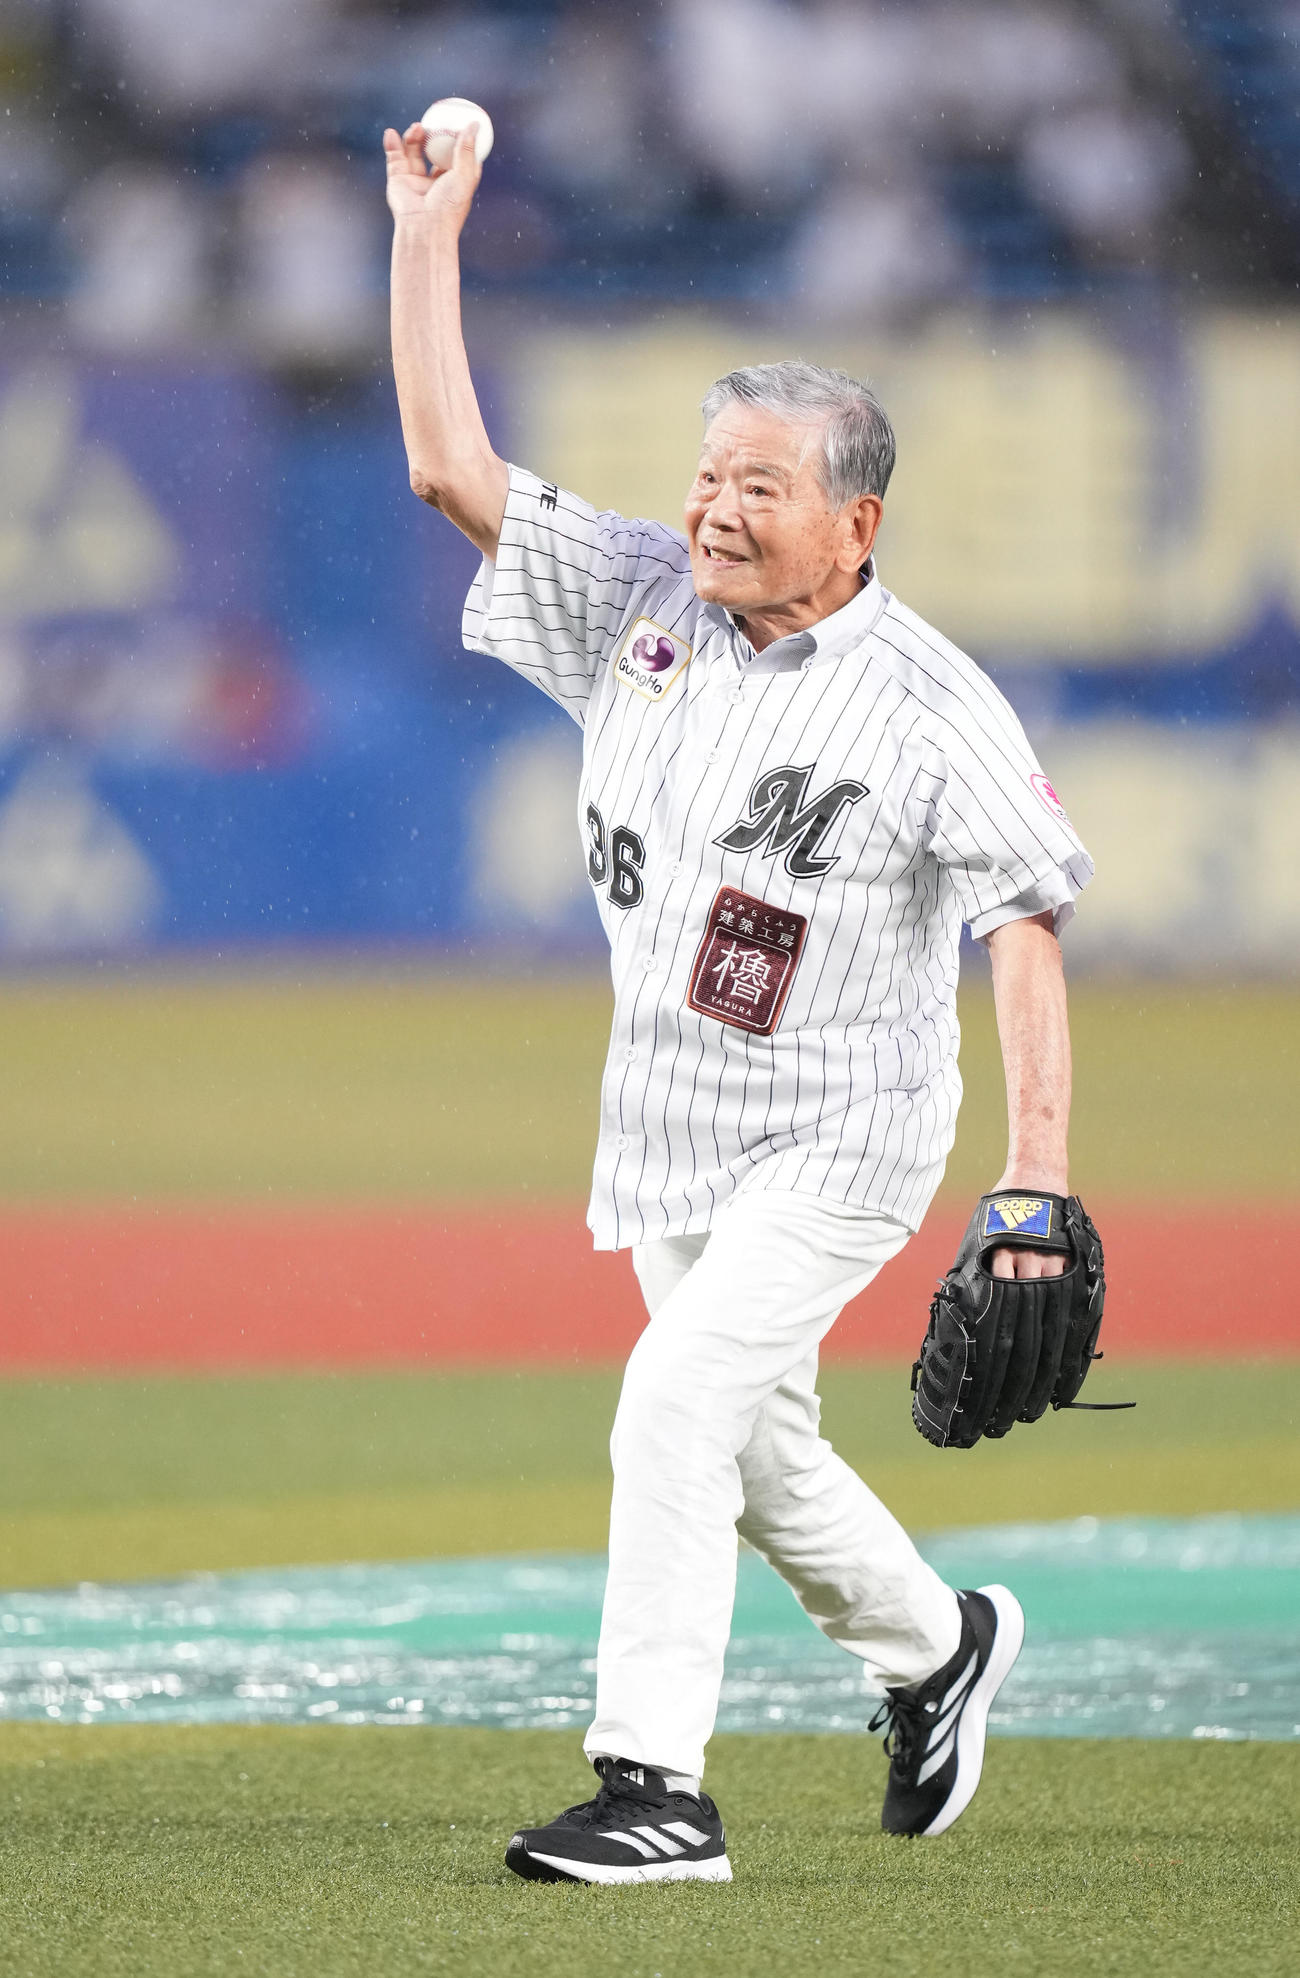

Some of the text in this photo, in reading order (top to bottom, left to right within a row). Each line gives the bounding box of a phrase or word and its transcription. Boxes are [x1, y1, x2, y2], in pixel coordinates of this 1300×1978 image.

[540, 483, 558, 512] TE
[618, 656, 663, 694] GungHo
[711, 762, 871, 879] M
[586, 801, 646, 910] 36
[718, 909, 796, 948] 建築工房
[711, 940, 772, 1005] 櫓
[710, 994, 752, 1017] YAGURA
